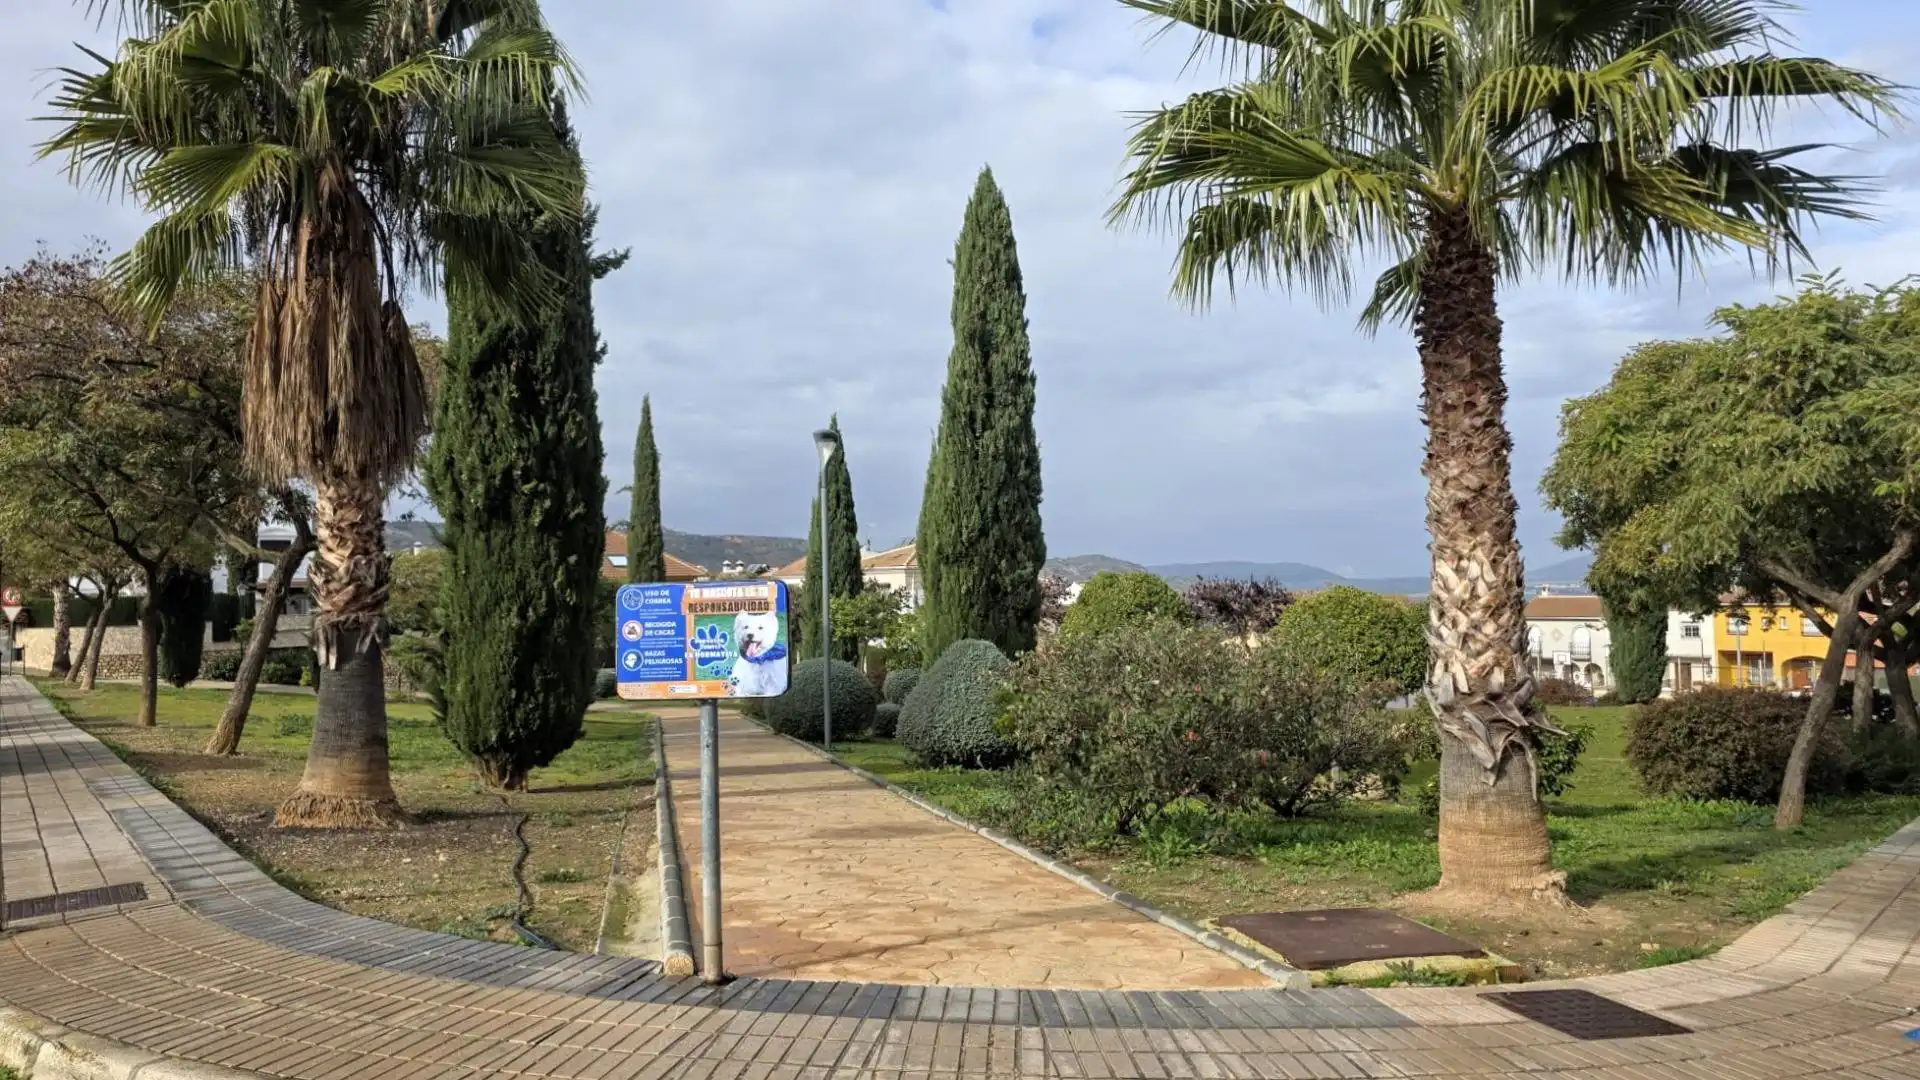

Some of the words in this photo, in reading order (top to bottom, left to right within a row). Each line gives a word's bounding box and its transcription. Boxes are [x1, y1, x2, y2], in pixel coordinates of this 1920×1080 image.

[645, 597, 672, 605] CORREA
[688, 600, 769, 613] RESPONSABILIDAD
[645, 621, 677, 629] RECOGIDA
[654, 629, 675, 637] CACAS
[645, 657, 683, 666] PELIGROSAS
